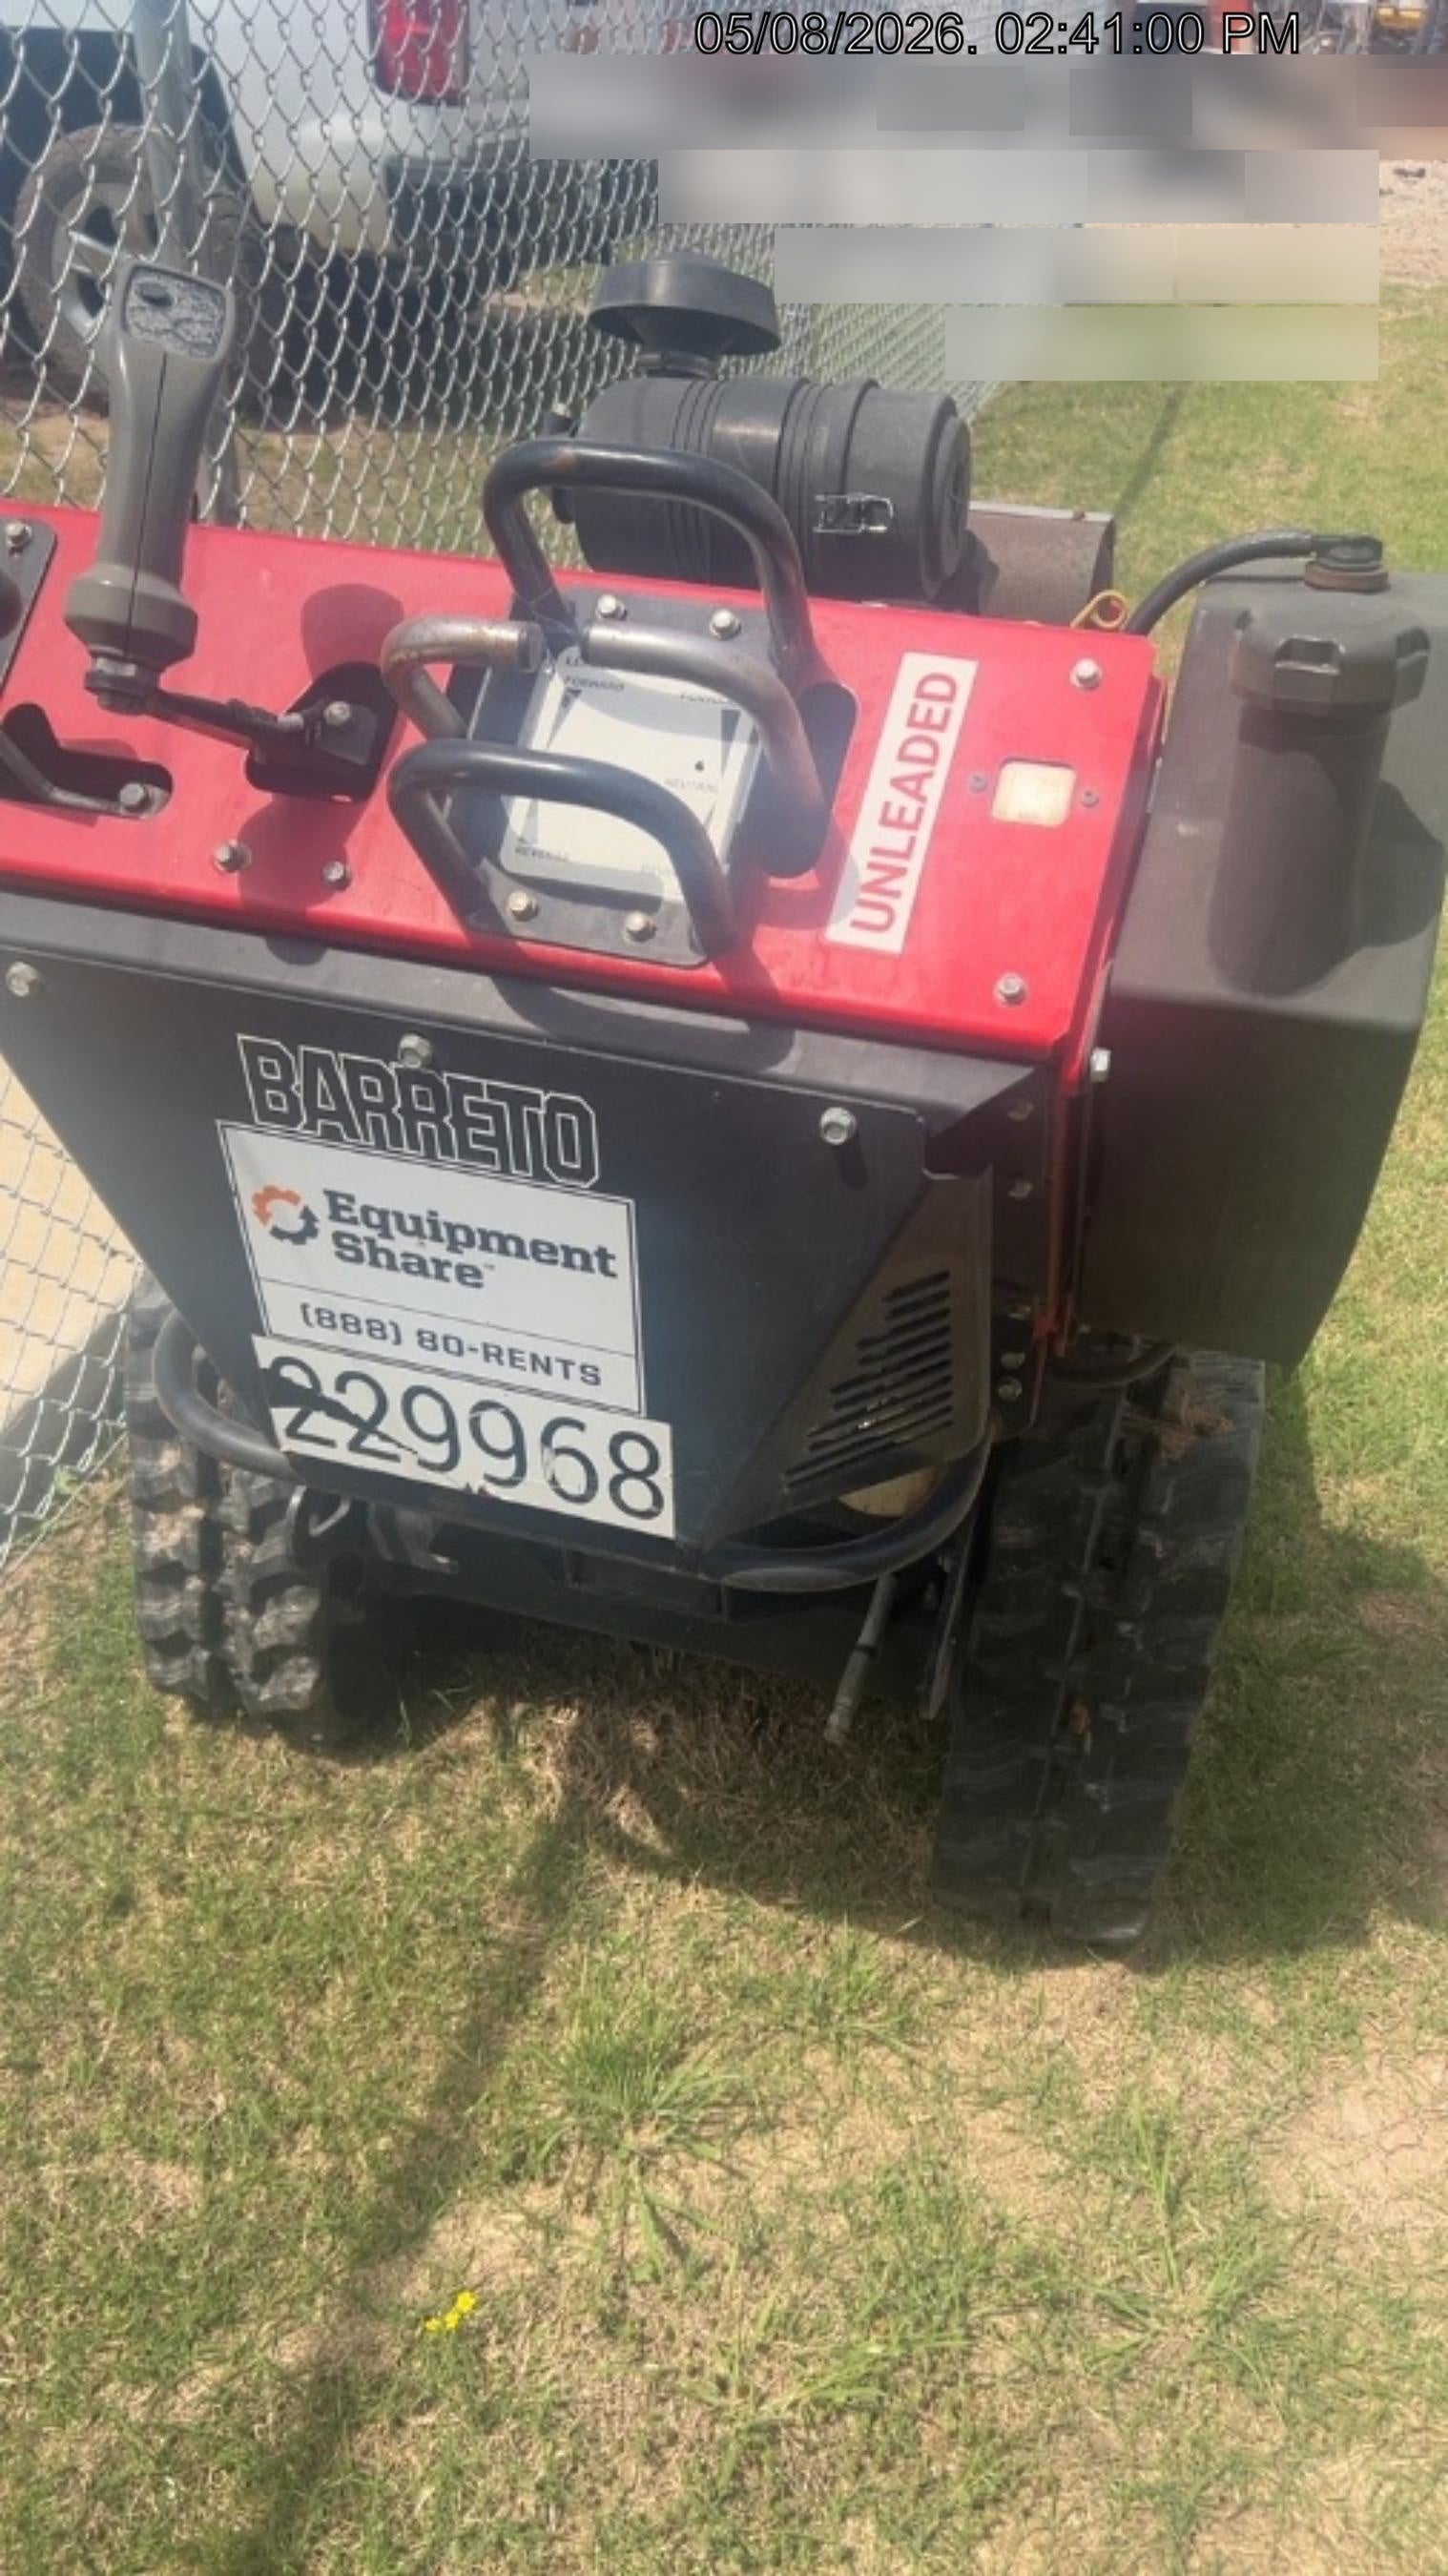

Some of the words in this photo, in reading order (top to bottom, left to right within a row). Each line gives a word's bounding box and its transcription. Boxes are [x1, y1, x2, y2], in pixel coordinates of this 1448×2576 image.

[850, 672, 958, 934] UNLEADED
[237, 1033, 600, 1189] BARRETO
[324, 1189, 618, 1279] Equipment
[300, 1301, 403, 1344] (888)
[416, 1330, 602, 1386] 80-RENTS
[269, 1356, 665, 1521] 229968
